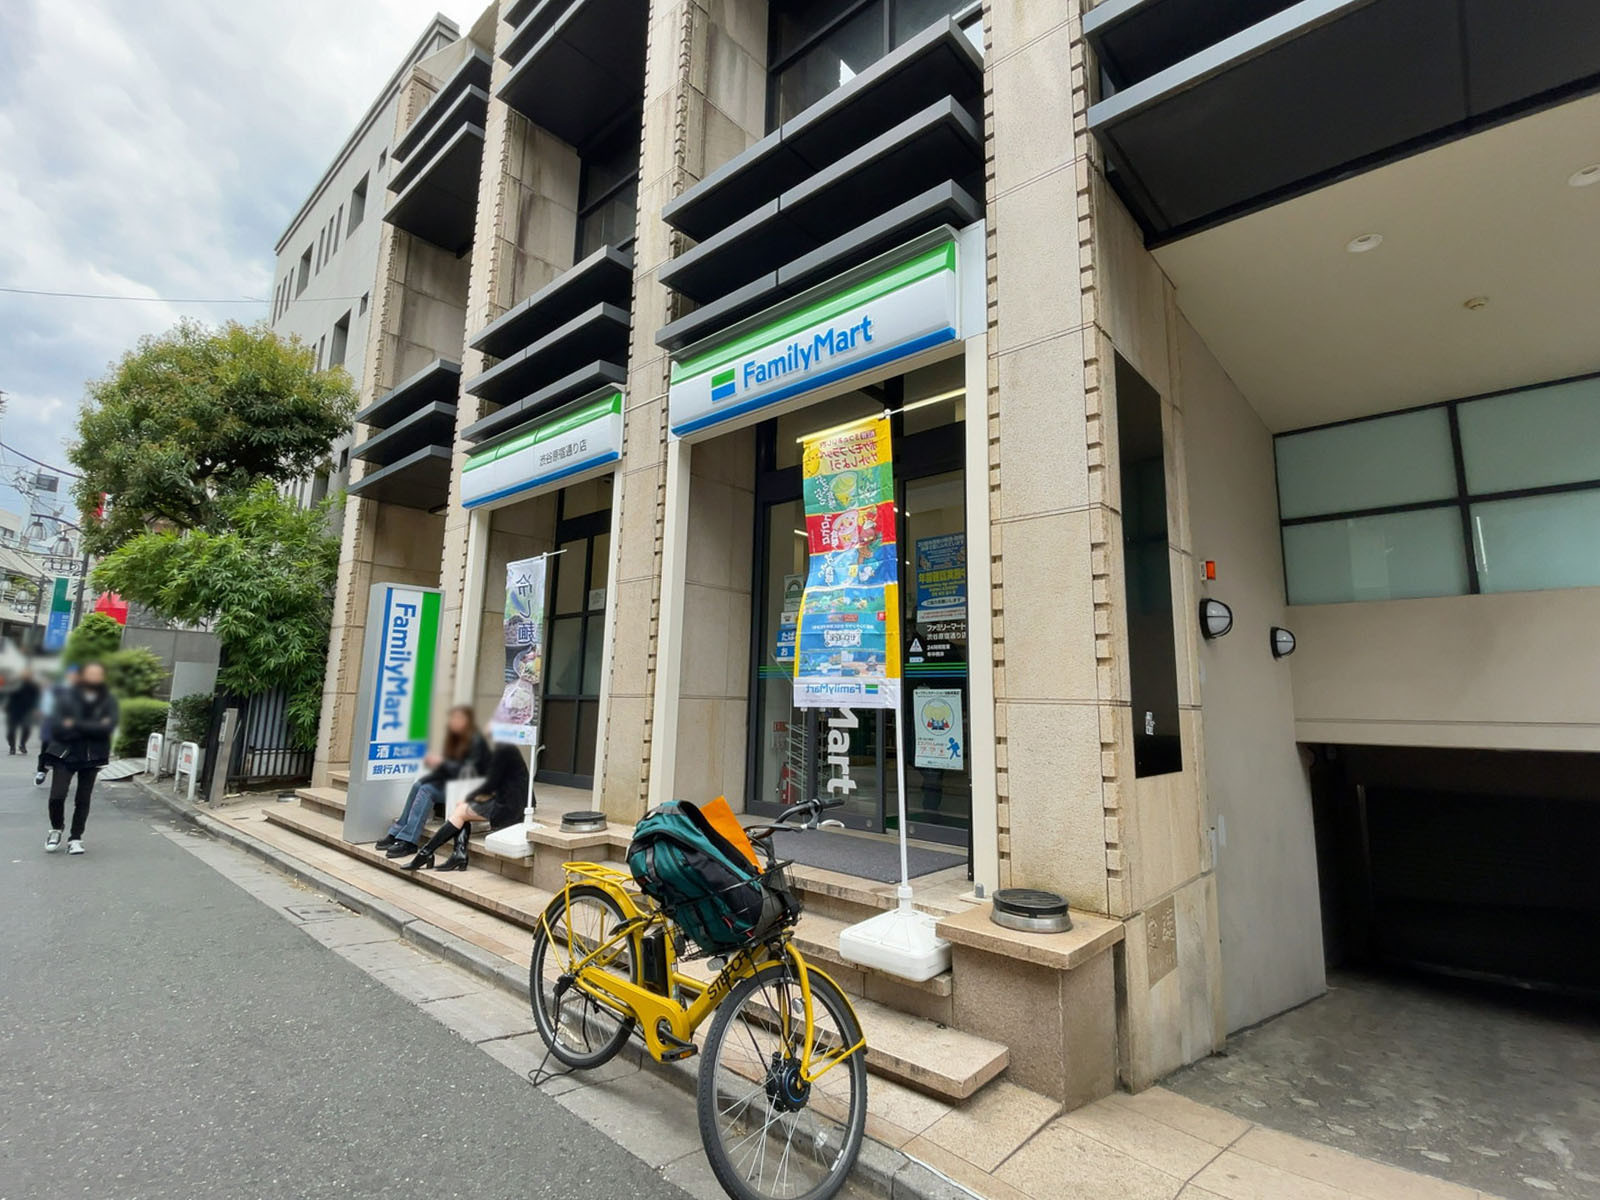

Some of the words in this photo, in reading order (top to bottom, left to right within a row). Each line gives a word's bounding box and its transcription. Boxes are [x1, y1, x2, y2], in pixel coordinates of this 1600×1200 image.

[743, 315, 873, 389] FamilyMart
[539, 439, 588, 467] 渋谷原宿通り店
[926, 623, 966, 632] ファミリーマート
[381, 602, 417, 731] FamilyMart
[376, 745, 390, 759] 酒
